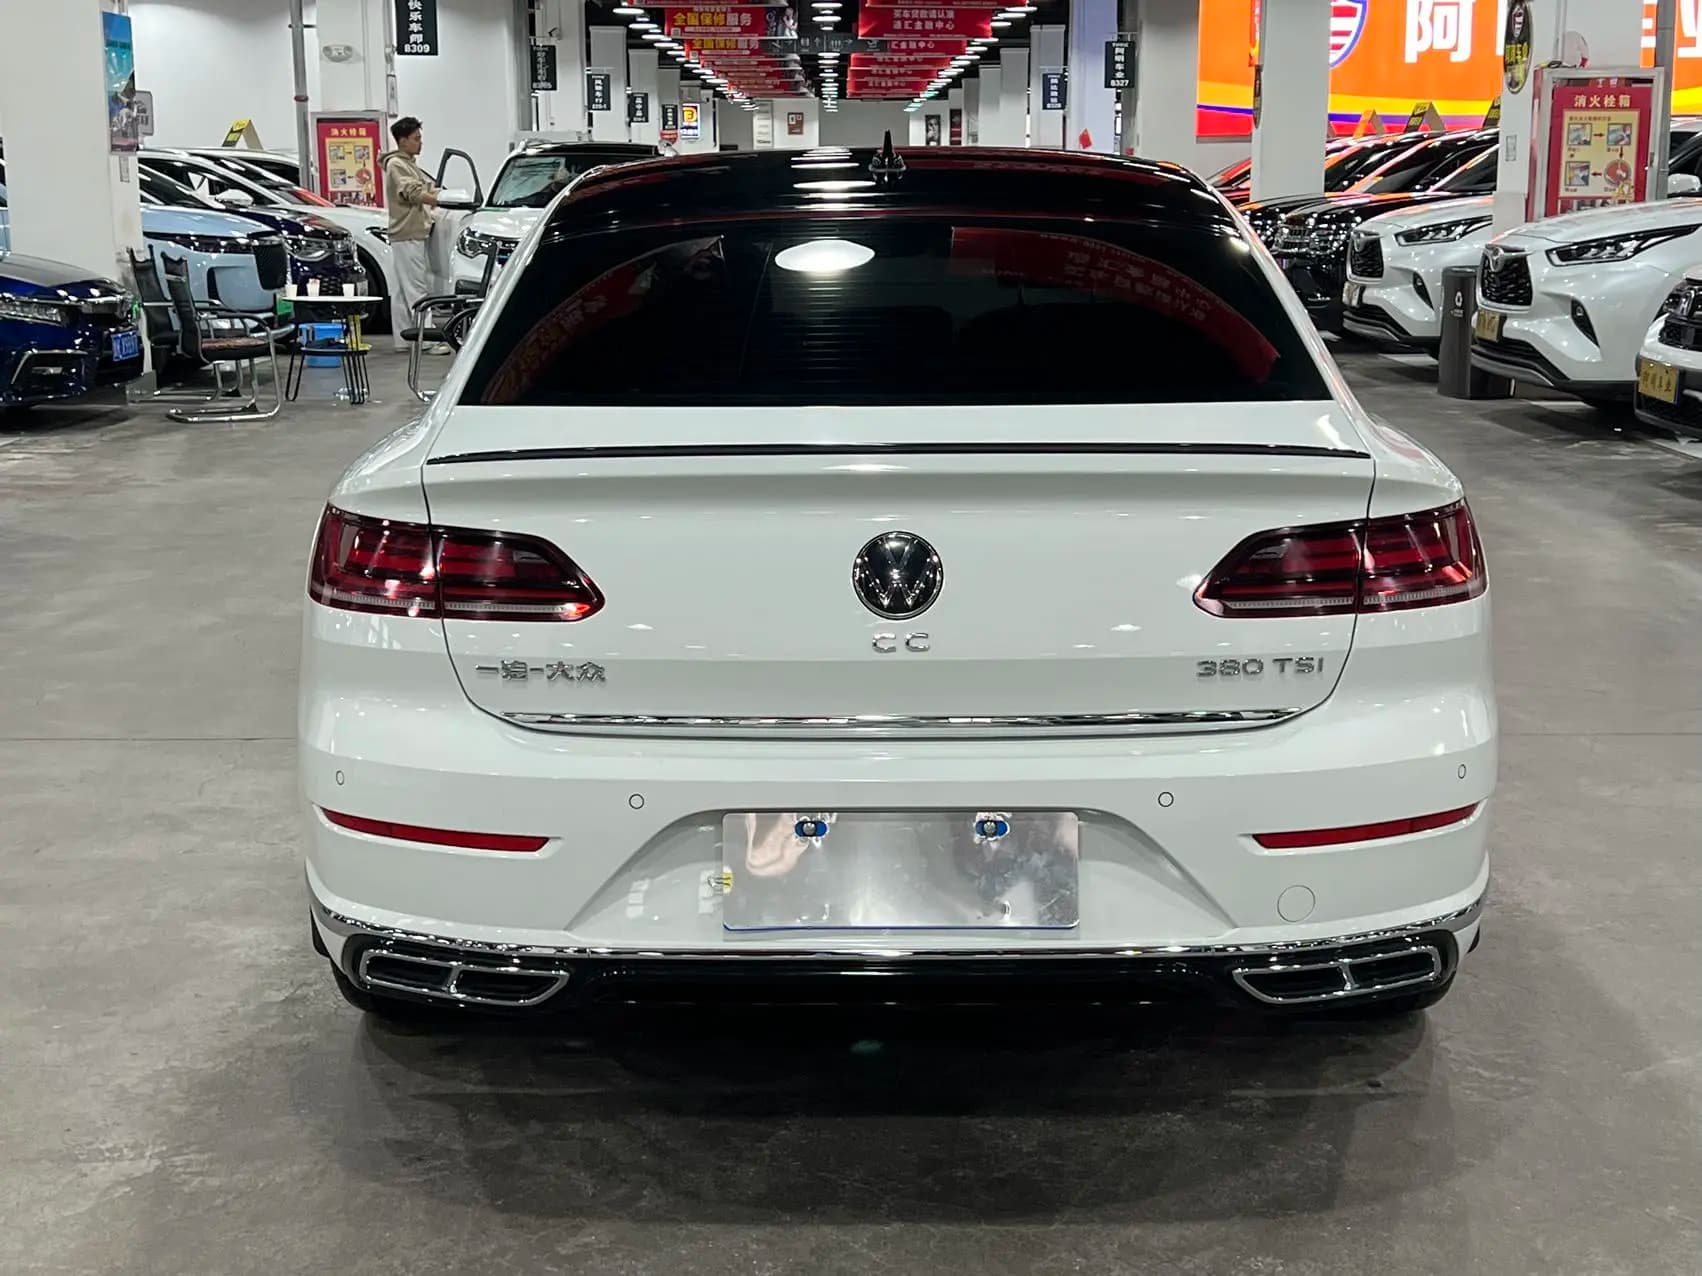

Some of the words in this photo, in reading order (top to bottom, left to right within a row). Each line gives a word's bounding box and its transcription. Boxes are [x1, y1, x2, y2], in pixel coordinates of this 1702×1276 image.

[674, 12, 752, 26] 全国保修服务
[404, 43, 430, 53] 8309
[887, 41, 935, 49] 汇金融中心
[1110, 79, 1129, 87] 8327
[1574, 95, 1631, 108] 消火栓箱
[872, 632, 930, 653] CC
[1197, 658, 1264, 677] 380
[1273, 656, 1324, 673] TSI
